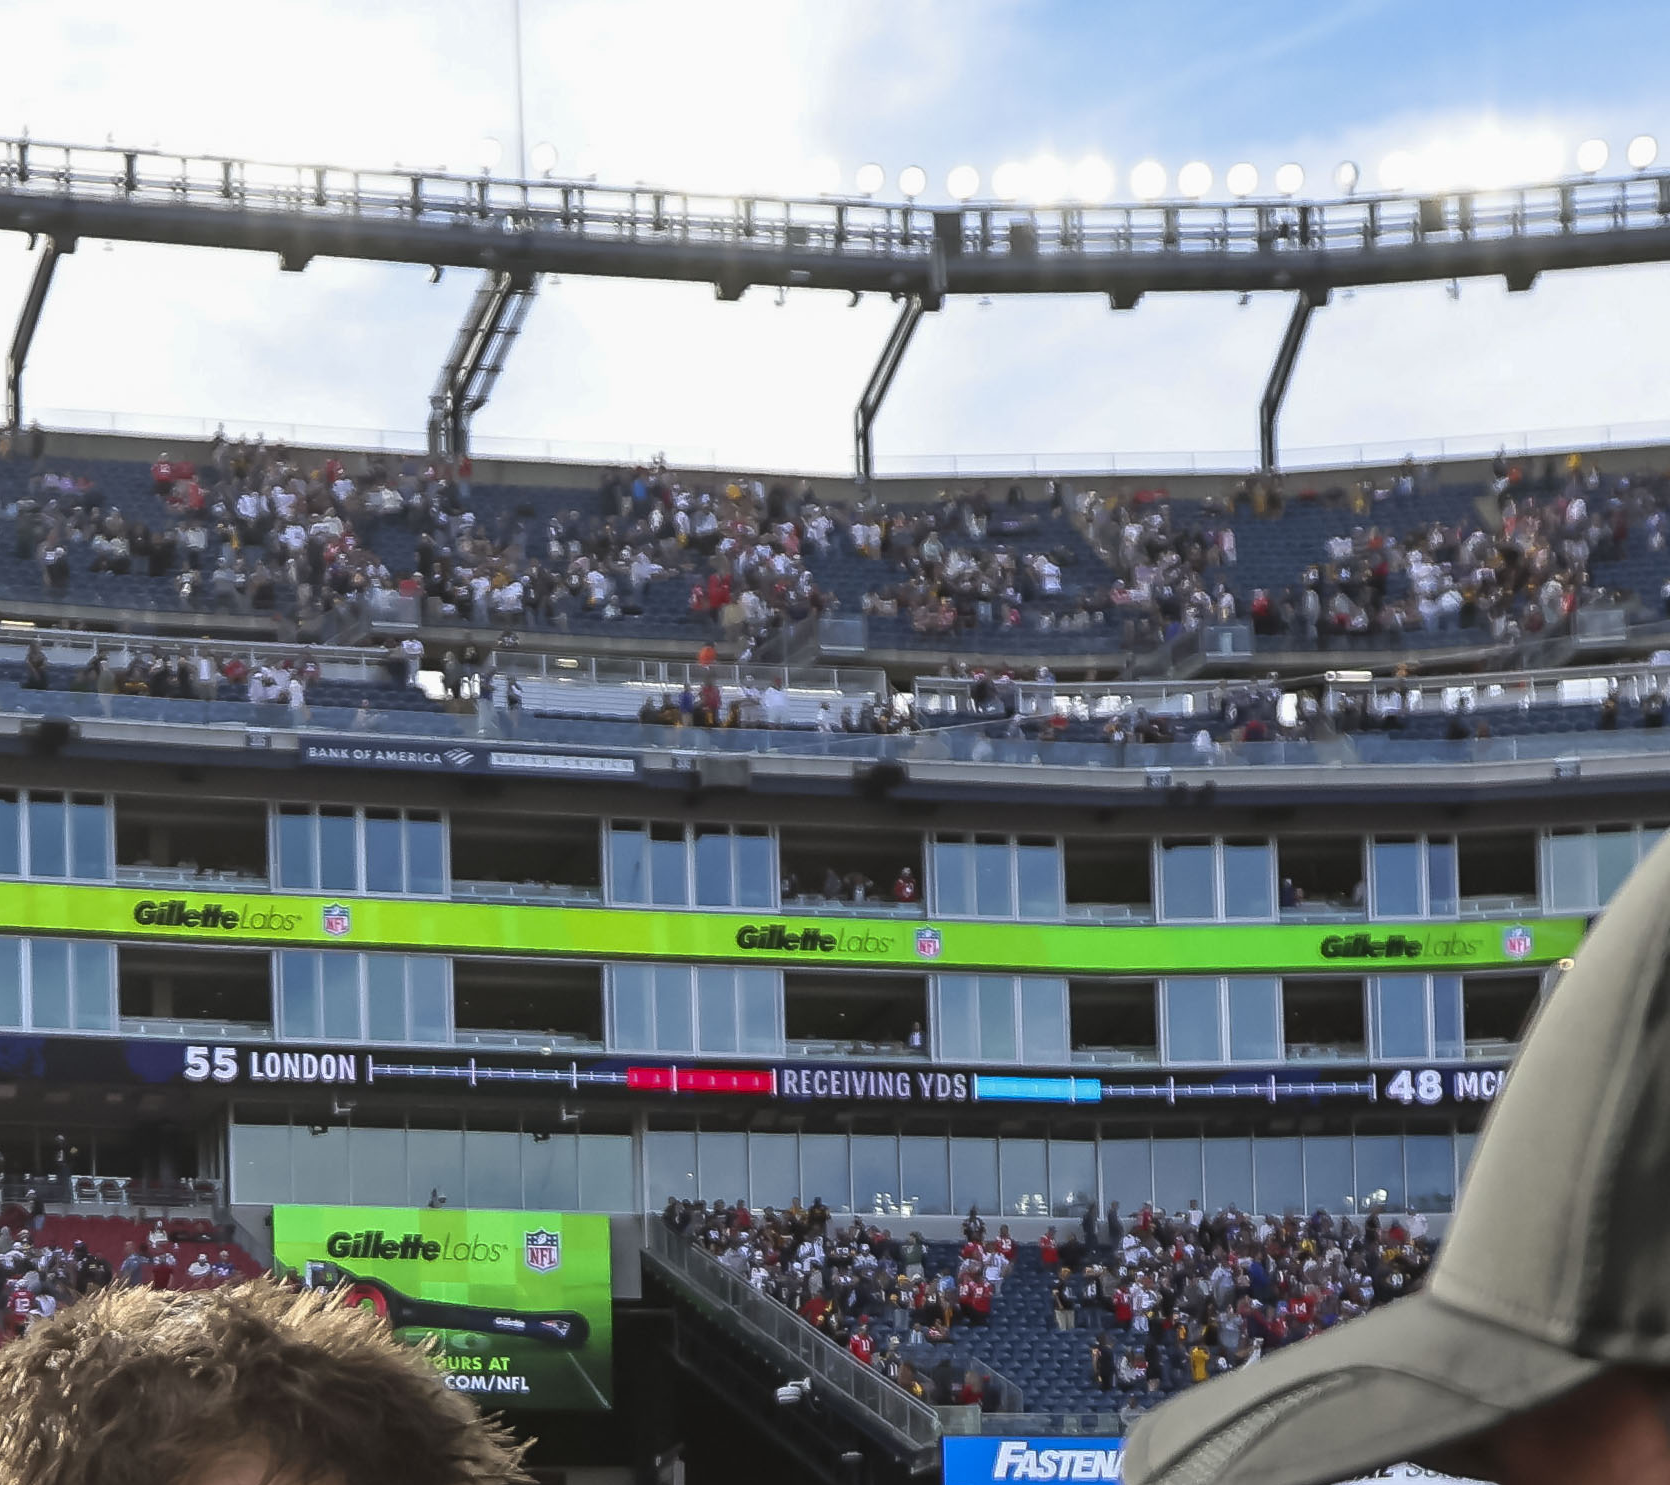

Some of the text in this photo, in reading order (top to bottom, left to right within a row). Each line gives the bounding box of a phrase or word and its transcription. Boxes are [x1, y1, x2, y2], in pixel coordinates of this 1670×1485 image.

[308, 746, 443, 765] BANK OF AMERICA
[182, 1046, 357, 1083] 55 LONDON
[782, 1070, 968, 1102] RECEIVING YDS
[1384, 1069, 1444, 1105] 48
[488, 1356, 511, 1372] AT
